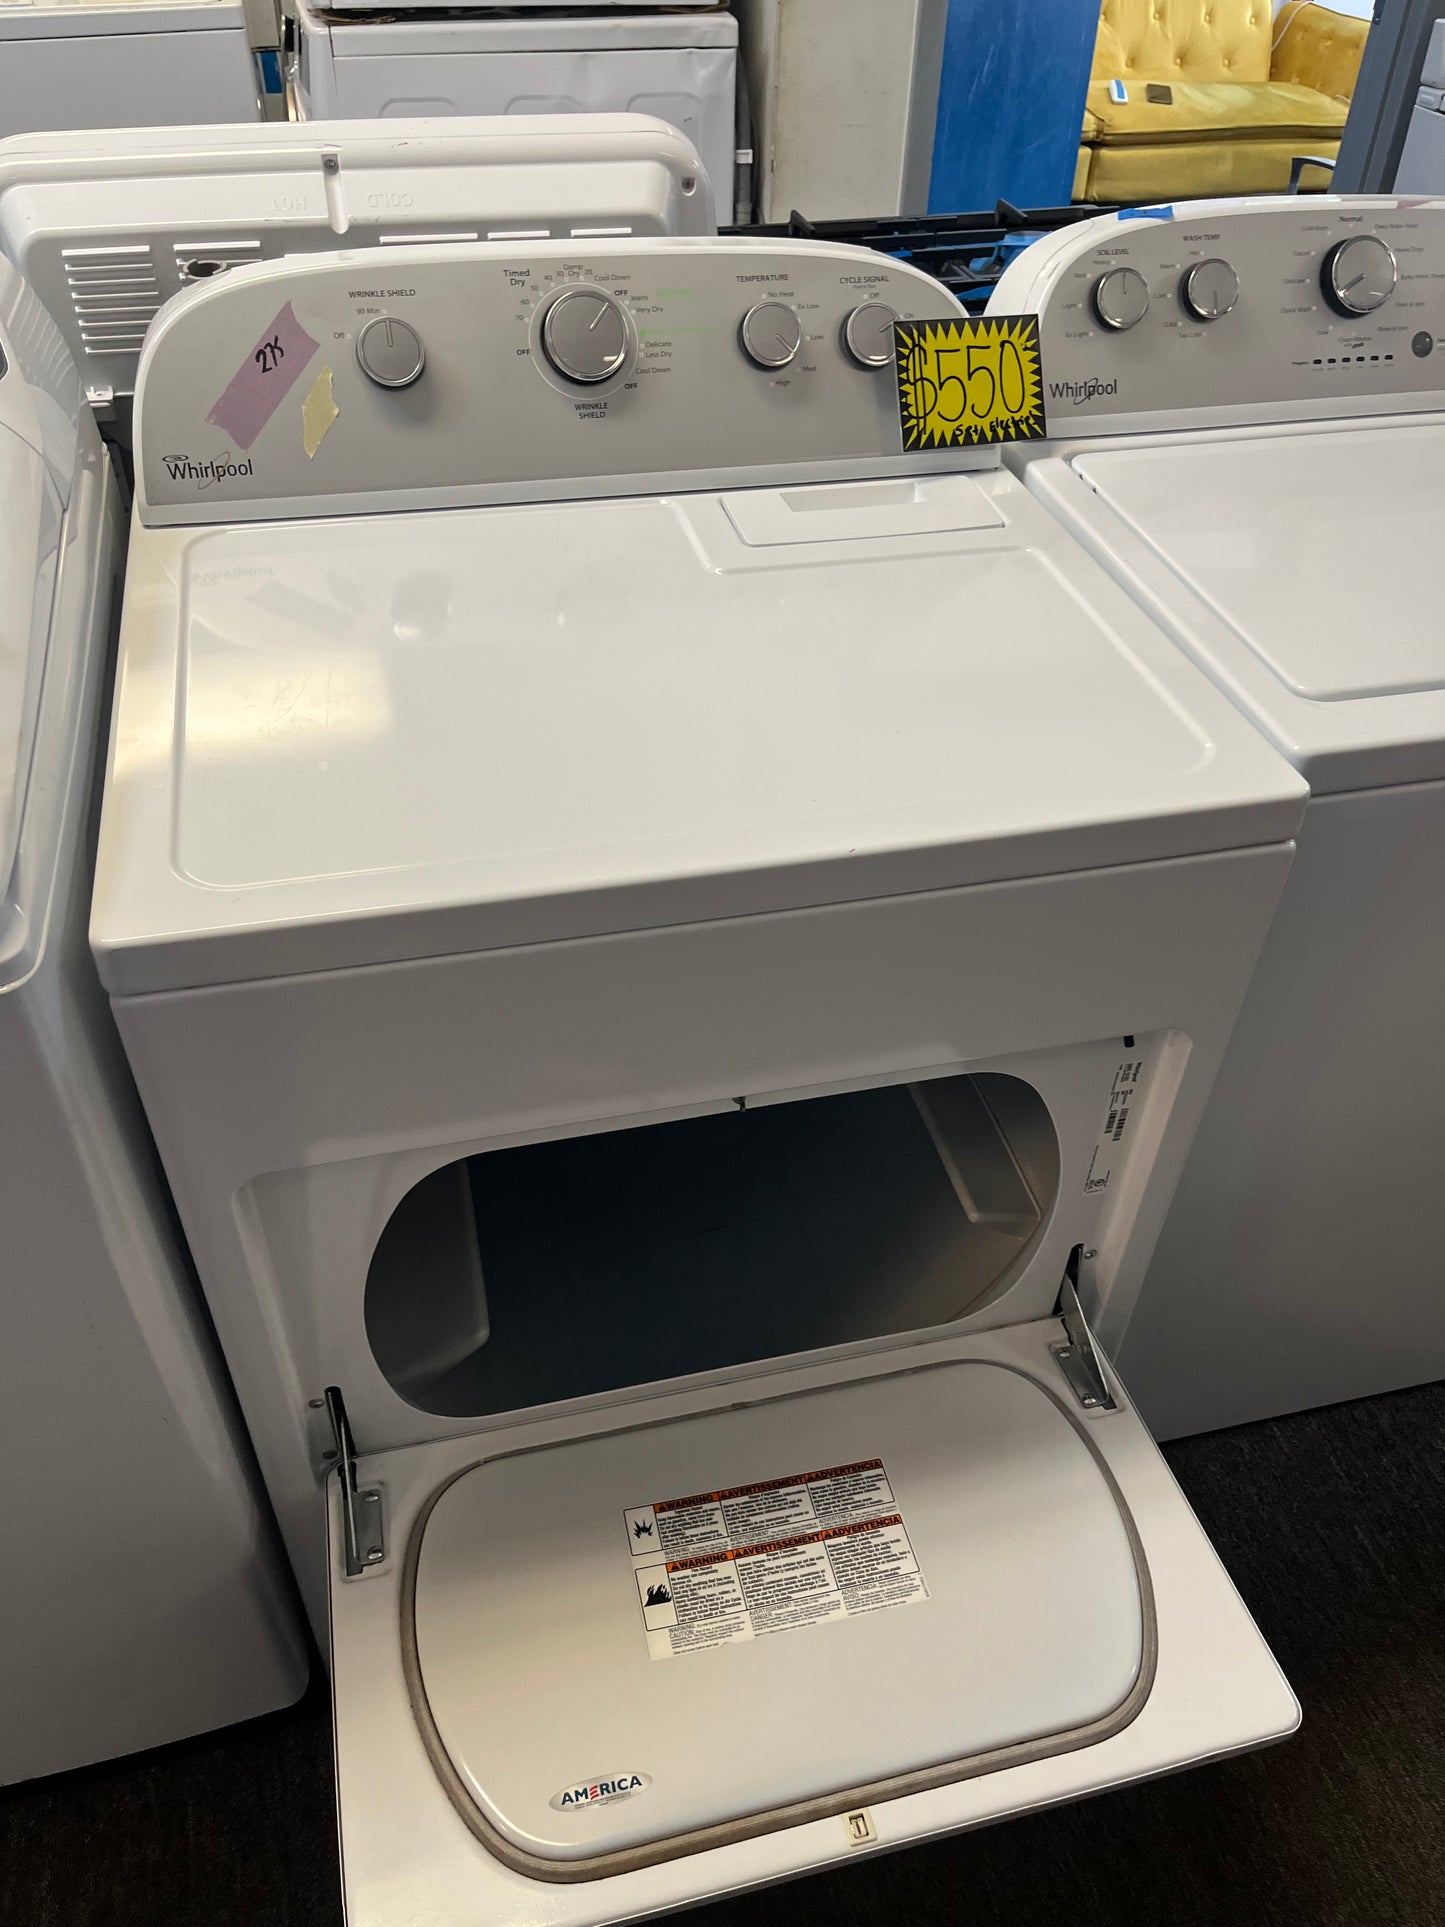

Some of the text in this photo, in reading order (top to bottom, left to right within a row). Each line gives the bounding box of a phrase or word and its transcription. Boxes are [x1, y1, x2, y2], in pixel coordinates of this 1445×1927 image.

[503, 268, 530, 277] Timed
[510, 278, 526, 287] Dry
[736, 274, 789, 283] TEMPERATURE
[839, 275, 889, 284] CYCLE SIGNAL
[349, 288, 416, 299] WRINKLE SHIELD
[356, 307, 365, 315] 90
[333, 331, 345, 340] Off
[516, 348, 530, 356] OFF
[906, 322, 1025, 435] $550
[624, 382, 638, 390] OFF
[1049, 378, 1117, 401] Whirlpool
[574, 402, 608, 411] WRINKLE
[579, 411, 606, 420] SHIELD
[167, 458, 253, 482] Whirlpool
[668, 1495, 713, 1509] WARNING
[816, 1460, 880, 1479] ADVERTENCIA
[680, 1553, 727, 1569] WARNING
[743, 1534, 820, 1556] AVERTISSEMENT
[833, 1516, 900, 1536] ADVERTENCIA
[561, 1775, 642, 1806] AMERICA
